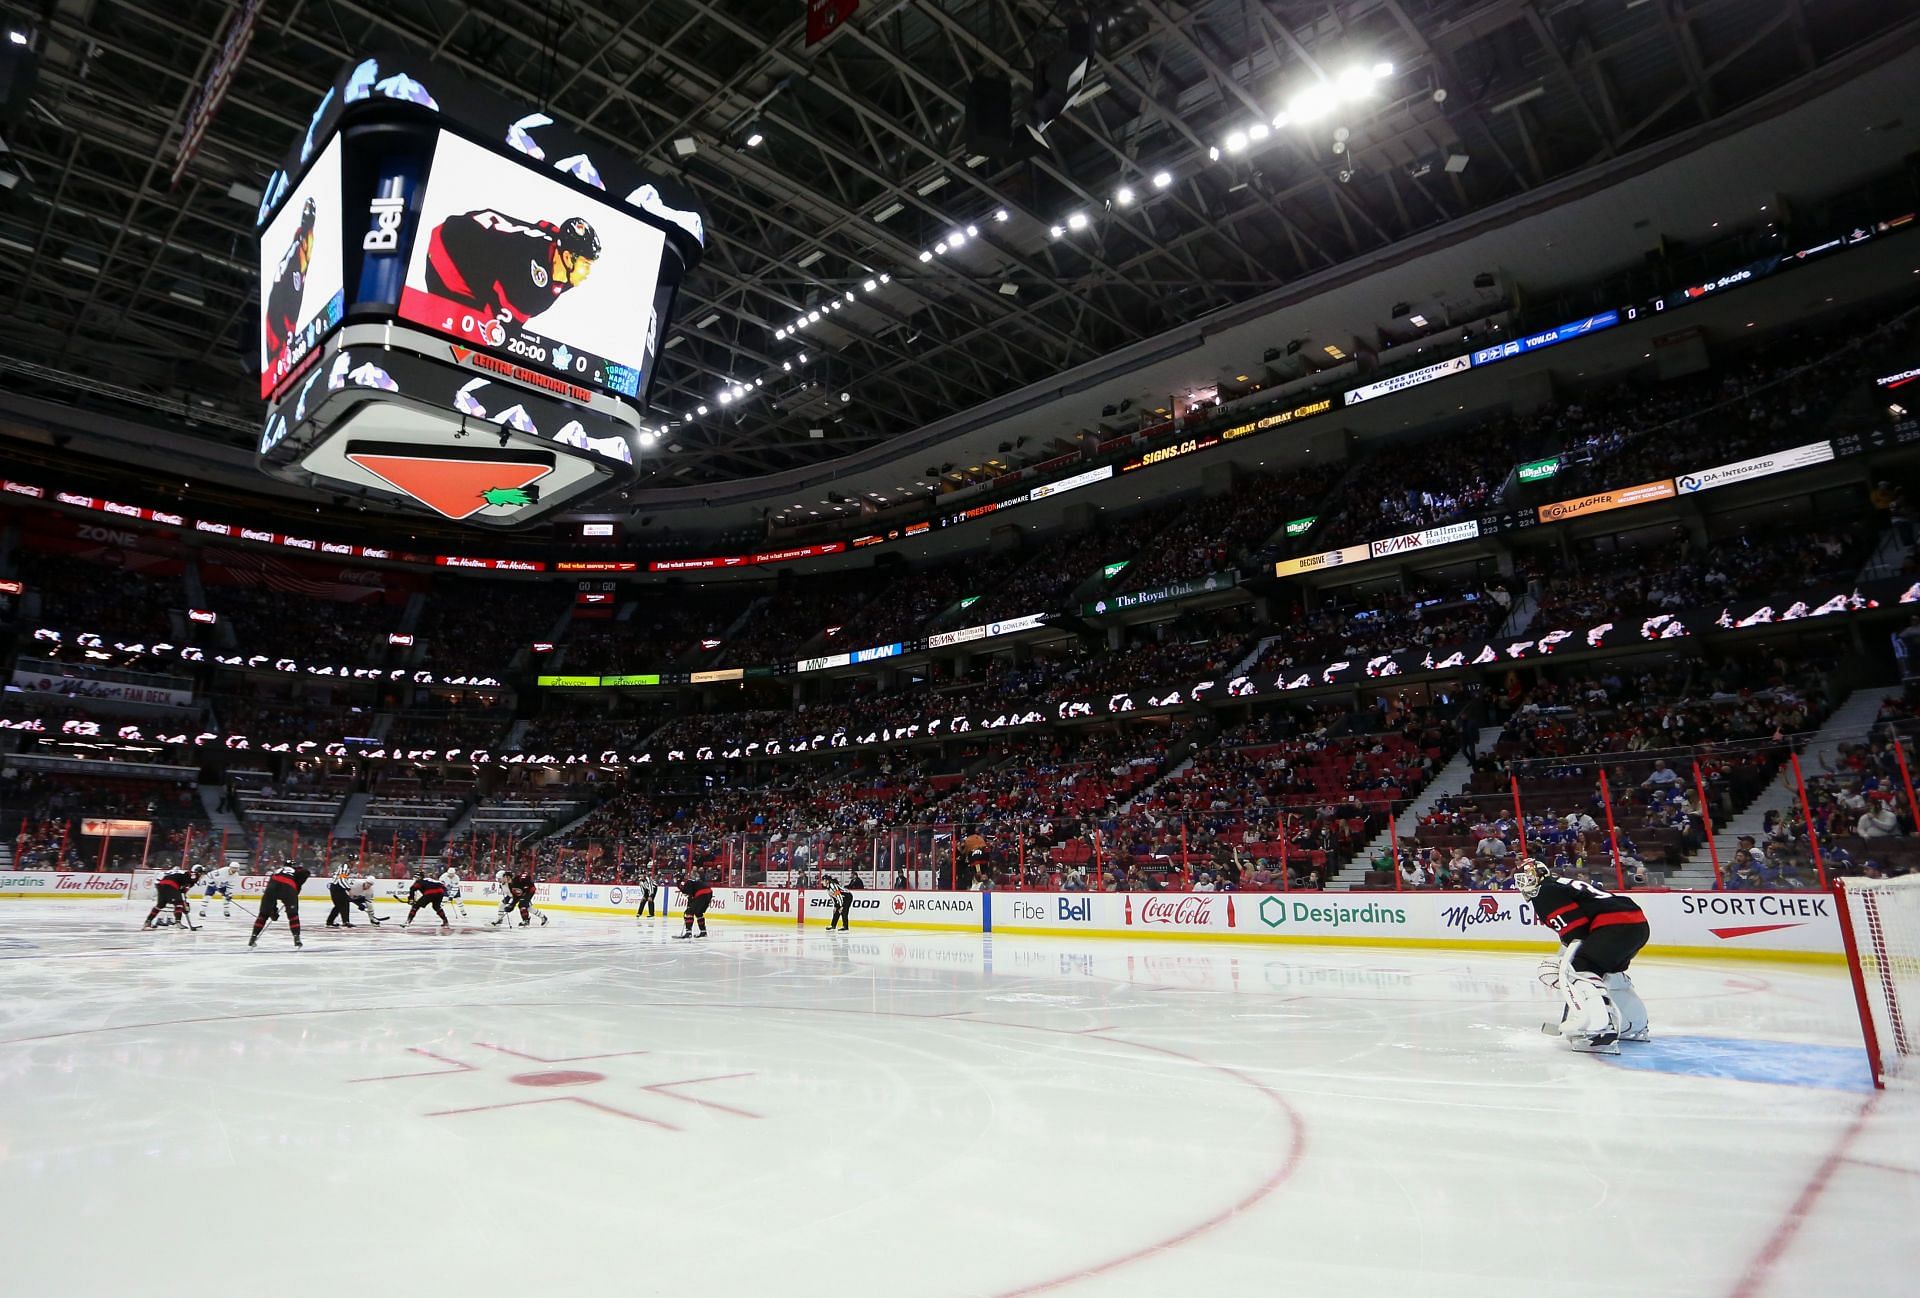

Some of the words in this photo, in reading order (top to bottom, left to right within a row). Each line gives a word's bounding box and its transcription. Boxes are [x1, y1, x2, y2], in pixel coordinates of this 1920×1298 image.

[363, 198, 404, 251] Bell
[1703, 282, 1716, 292] to
[1718, 270, 1751, 287] skate
[461, 315, 475, 332] 0
[1526, 331, 1558, 348] YOW.CA
[507, 337, 546, 362] 20:00
[576, 357, 587, 372] 0
[1371, 376, 1406, 391] ACCESS
[1408, 362, 1450, 381] RIGGING
[1388, 374, 1434, 392] SERVICES
[1142, 440, 1197, 466] SIGNS.CA
[1703, 461, 1774, 482] DA-INTEGRATED
[1518, 508, 1534, 517] 324
[1552, 495, 1612, 516] GALLAGHER
[1482, 516, 1497, 525] 323
[1519, 518, 1535, 528] 224
[77, 524, 139, 547] ZONE
[1425, 521, 1476, 539] Hallmark
[1426, 535, 1451, 546] Realty
[1451, 530, 1478, 542] Group
[1483, 525, 1498, 535] 223
[1373, 534, 1424, 556] RE/MAX
[446, 557, 459, 566] Tim
[459, 558, 487, 568] Hortons
[756, 554, 769, 562] Find
[769, 552, 783, 560] what
[800, 549, 811, 557] you
[1299, 555, 1325, 568] DECISIVE
[495, 560, 509, 569] Tim
[509, 561, 536, 571] Hortons
[578, 582, 591, 591] GO
[1116, 596, 1137, 608] The
[1138, 591, 1169, 604] Royal
[1170, 583, 1193, 595] Oak
[1003, 621, 1029, 631] GOWLING
[805, 657, 828, 671] MNP
[123, 687, 144, 701] FAN
[144, 689, 173, 705] DECK
[56, 874, 81, 890] Tim
[733, 891, 744, 903] The
[744, 891, 791, 913] BRICK
[908, 899, 926, 911] AIR
[927, 899, 974, 912] CANADA
[1013, 901, 1045, 919] Fibe
[1058, 897, 1091, 921] Bell
[1141, 896, 1211, 925] Coca-Cola
[1293, 902, 1406, 927] Desjardins
[1441, 896, 1512, 933] Molson
[1549, 914, 1569, 931] 31
